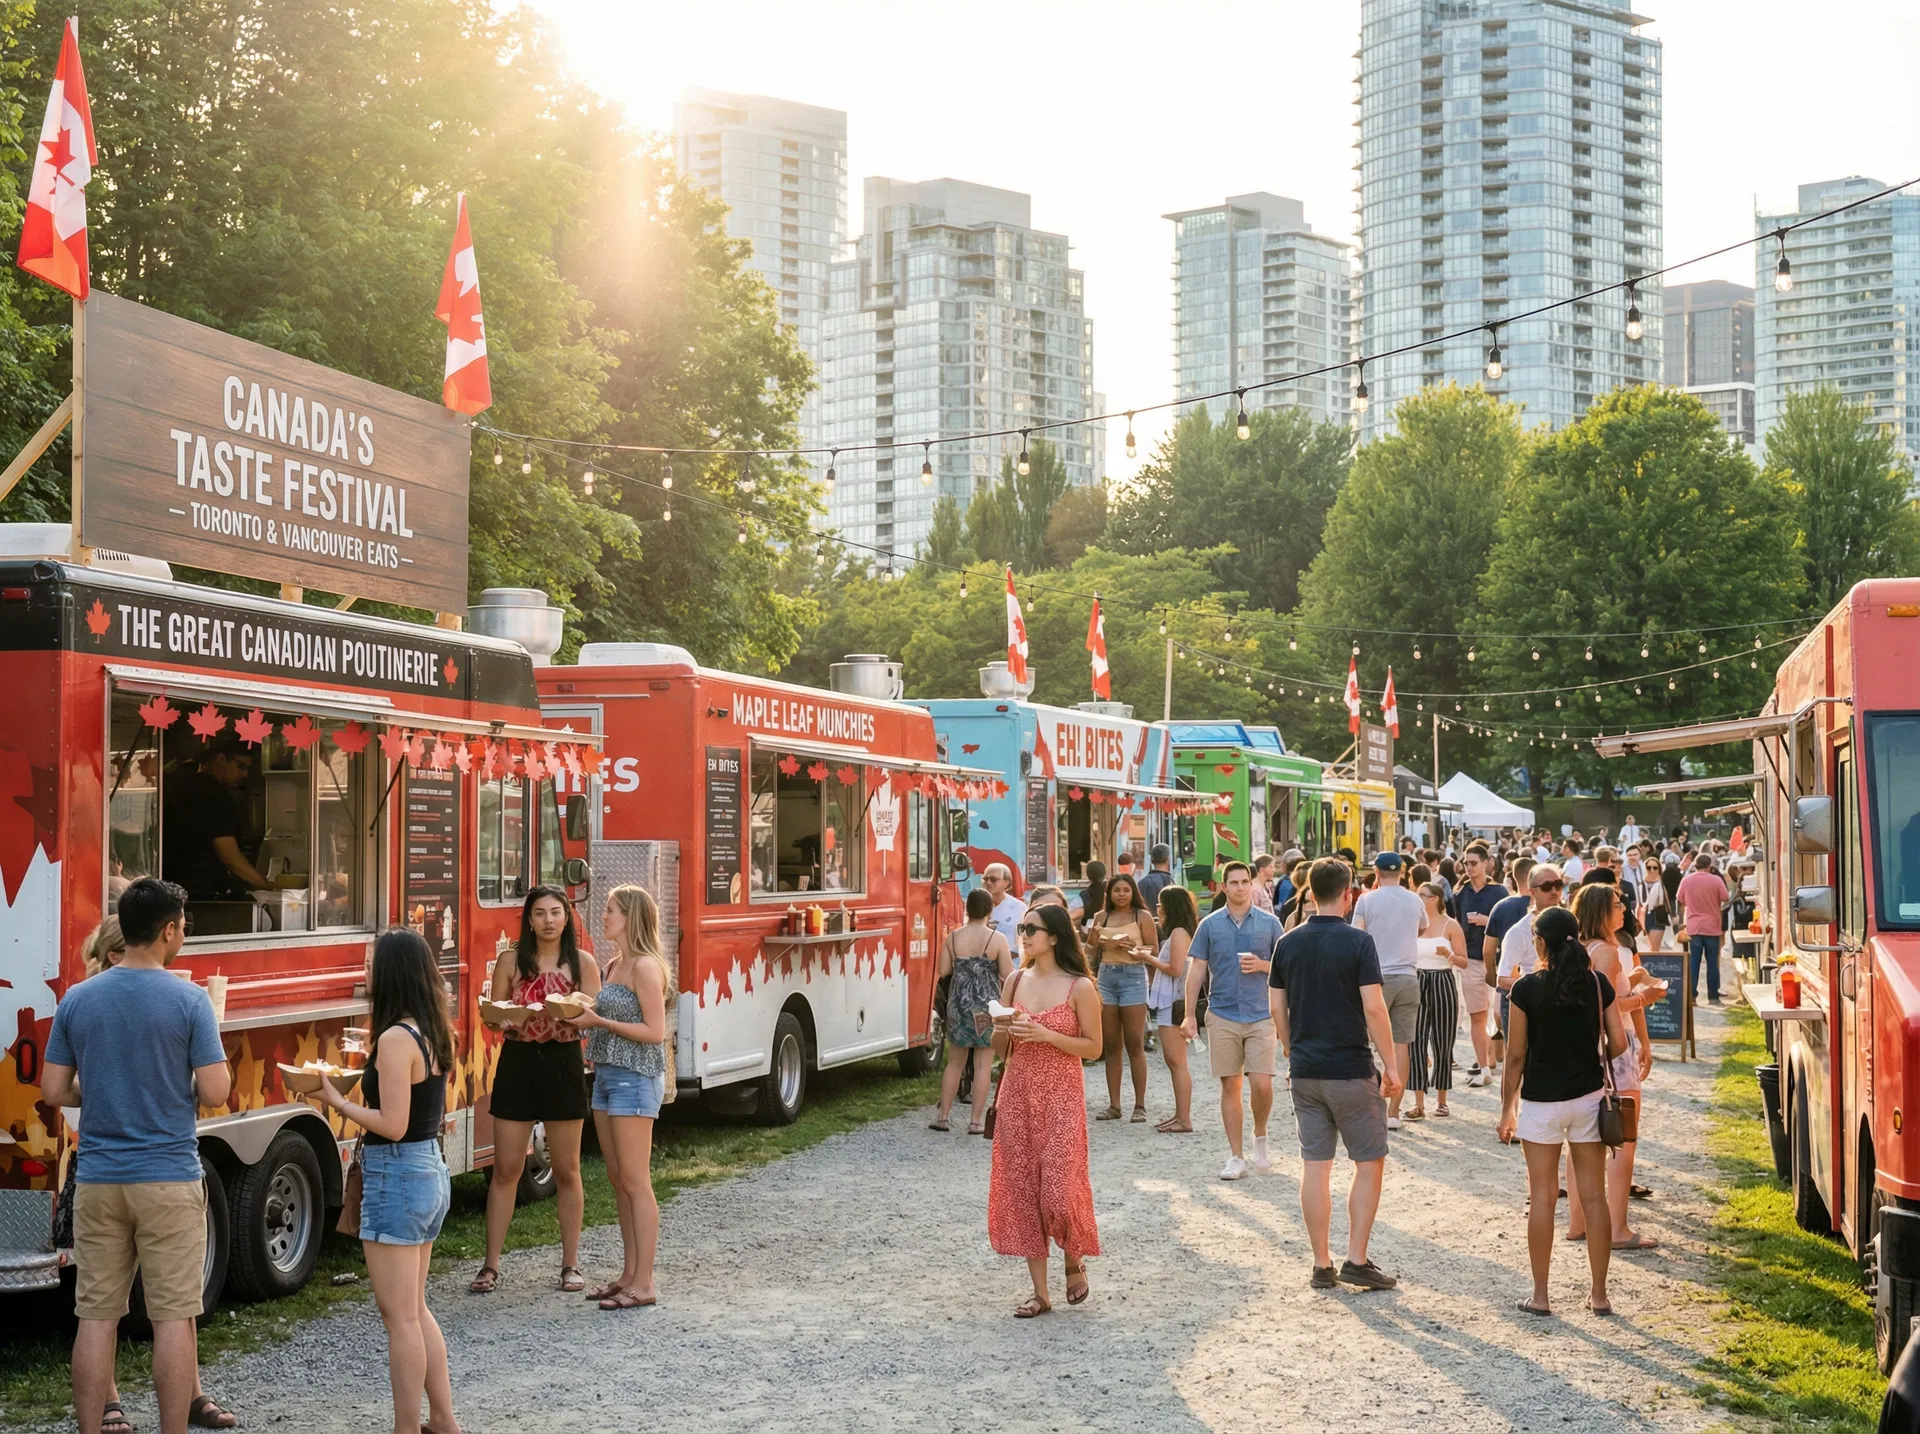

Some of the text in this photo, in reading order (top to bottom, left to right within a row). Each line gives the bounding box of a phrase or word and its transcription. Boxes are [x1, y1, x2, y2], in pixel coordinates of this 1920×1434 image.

[223, 375, 375, 467] CANADA'S
[170, 428, 413, 538] TASTE FESTIVAL
[190, 501, 399, 569] TORONTO & VANCOUVER EATS
[118, 604, 438, 687] THE GREAT CANADIAN POUTINERIE
[732, 692, 875, 743] MAPLE LEAF MUNCHIES
[1056, 722, 1123, 772] EH! BITES
